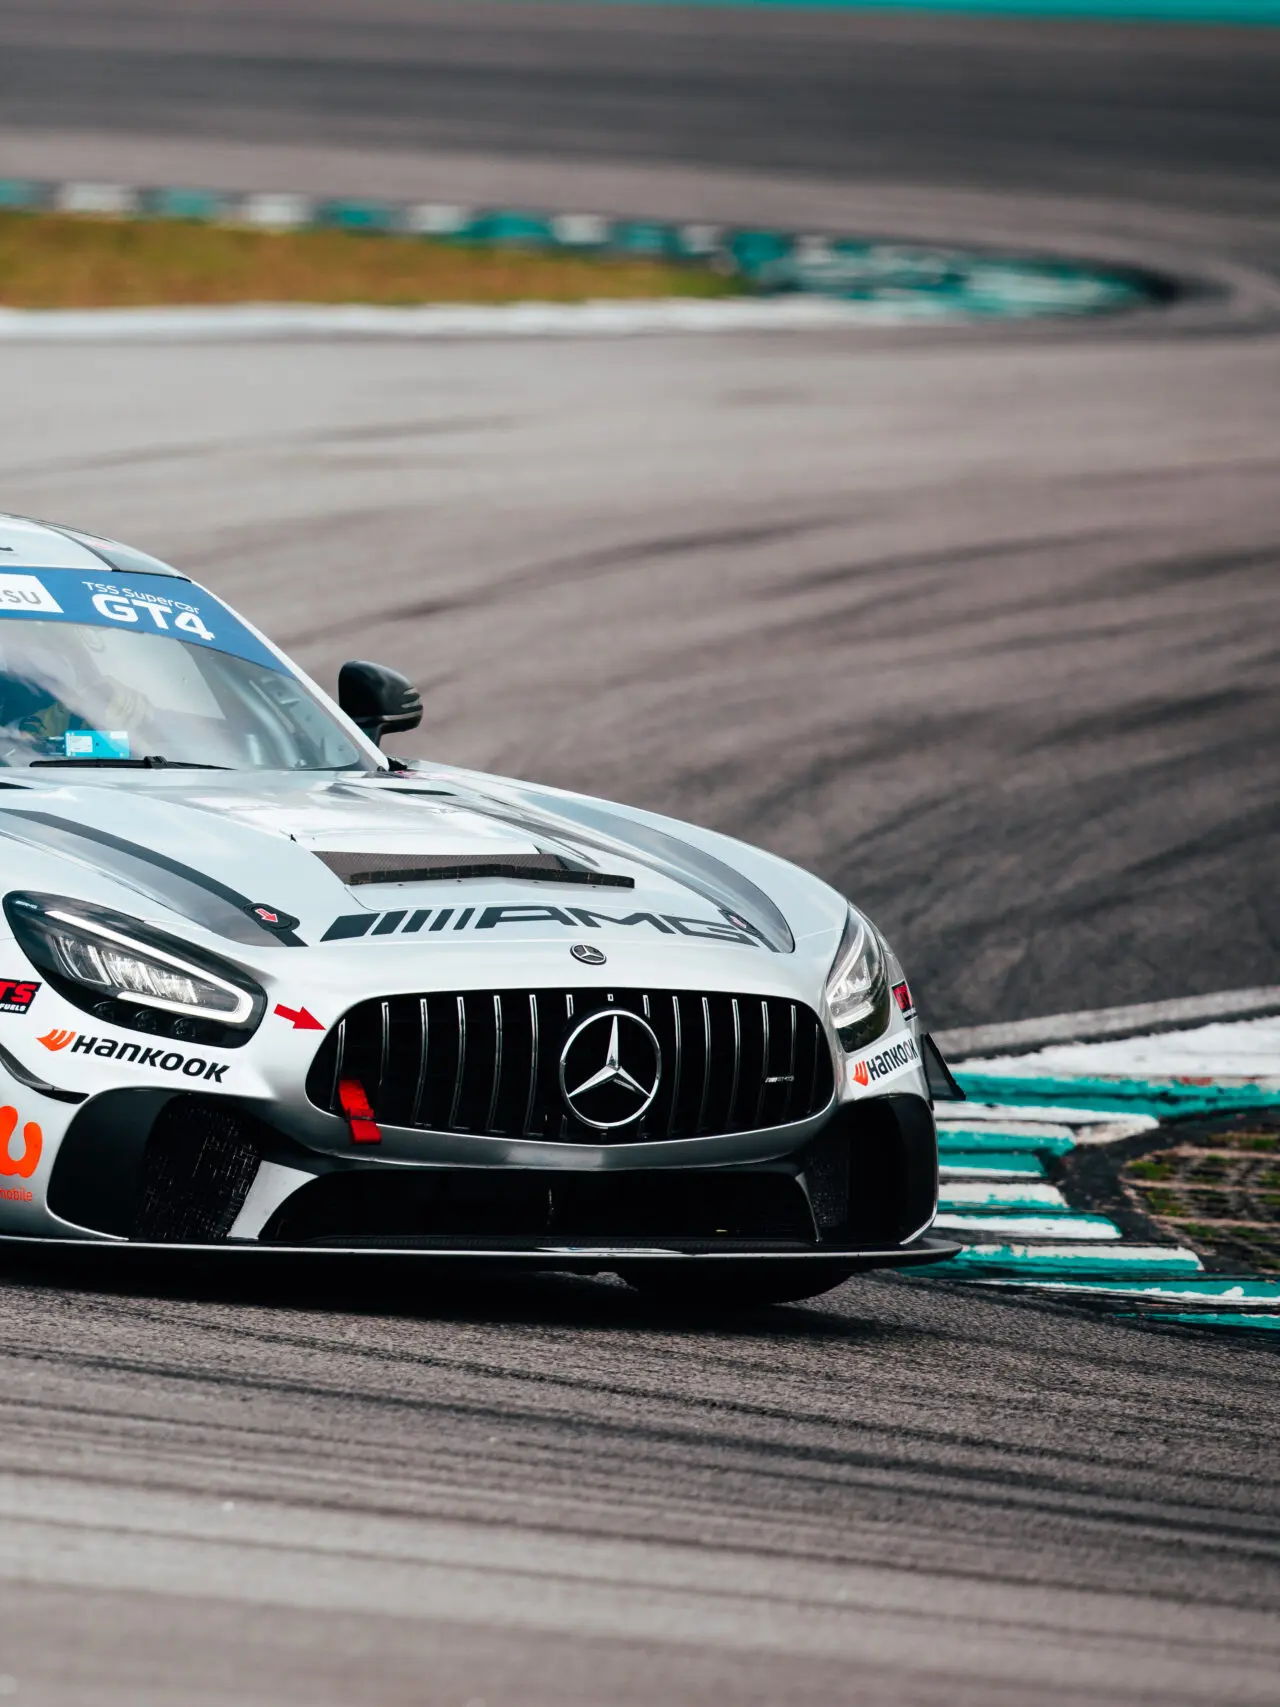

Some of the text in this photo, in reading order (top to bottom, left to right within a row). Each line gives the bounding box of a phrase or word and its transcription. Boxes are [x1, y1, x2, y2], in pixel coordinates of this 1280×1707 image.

[82, 580, 200, 615] TSS Supercar
[91, 593, 216, 641] GT4
